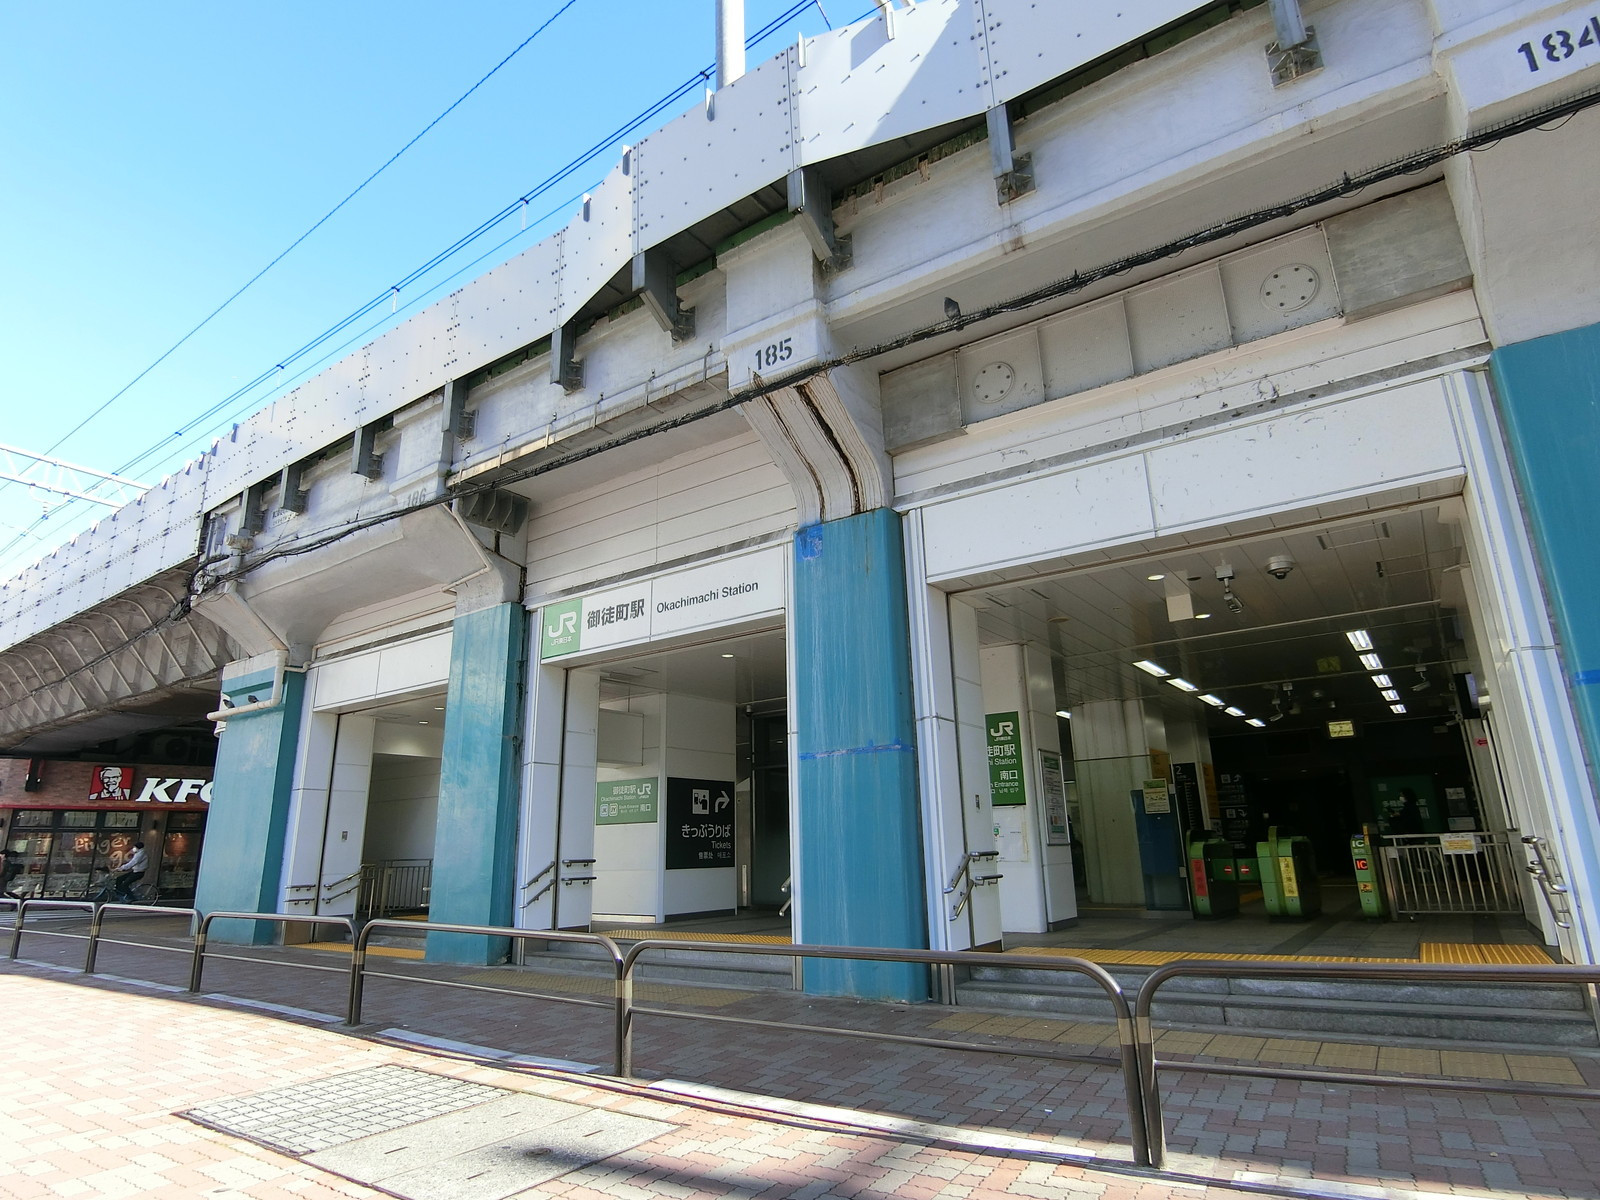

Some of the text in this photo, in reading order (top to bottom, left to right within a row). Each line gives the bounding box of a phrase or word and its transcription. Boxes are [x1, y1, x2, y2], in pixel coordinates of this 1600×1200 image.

[1517, 16, 1600, 72] 184
[755, 337, 792, 370] 185
[656, 580, 759, 613] Okachimachi Station
[587, 598, 645, 629] 御徒町駅
[548, 611, 577, 638] JR
[990, 721, 1014, 737] JR
[994, 758, 1017, 766] Station
[1000, 770, 1018, 780] 南口
[637, 783, 651, 795] JR
[681, 824, 731, 838] きっぷうりば
[711, 840, 731, 849] Tickets
[1352, 839, 1365, 847] IC
[1356, 860, 1368, 869] IC
